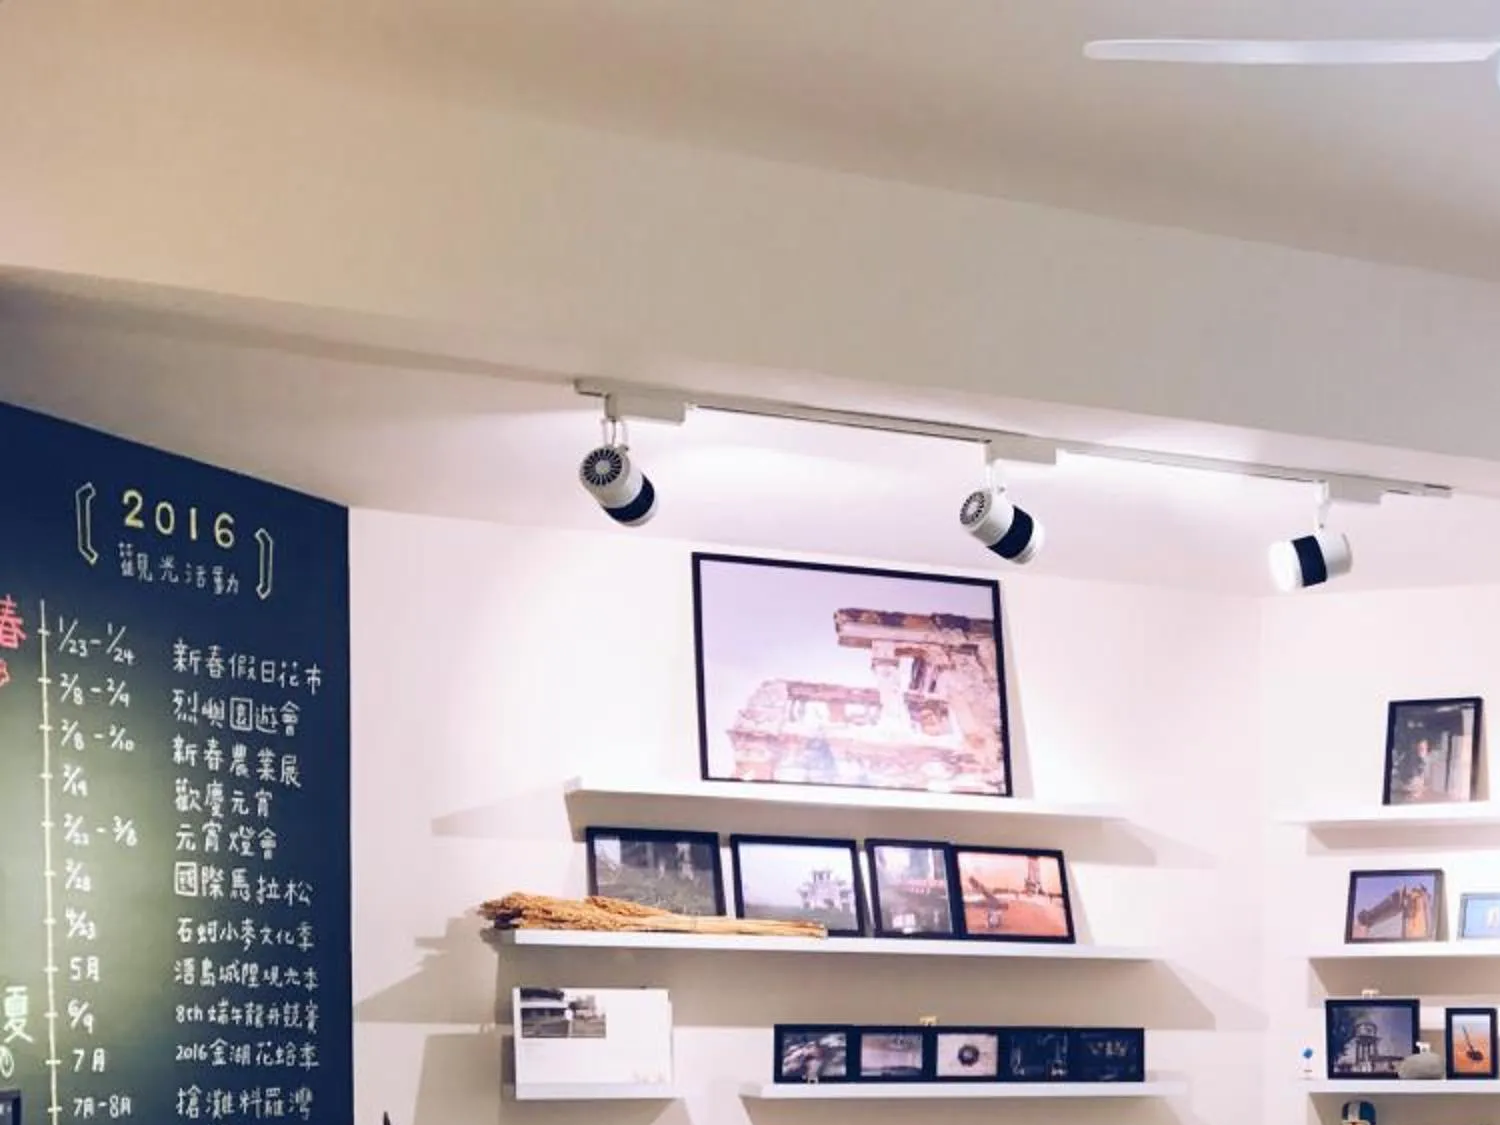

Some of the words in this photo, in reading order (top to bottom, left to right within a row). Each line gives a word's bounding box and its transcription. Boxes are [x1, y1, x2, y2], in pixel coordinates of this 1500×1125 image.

[123, 489, 236, 548] 2016
[118, 542, 240, 595] 觀光活動
[172, 637, 321, 695] 新春假日花市
[172, 733, 301, 788] 新春農業展
[174, 861, 314, 906] 國際馬拉松
[4, 985, 34, 1044] 夏
